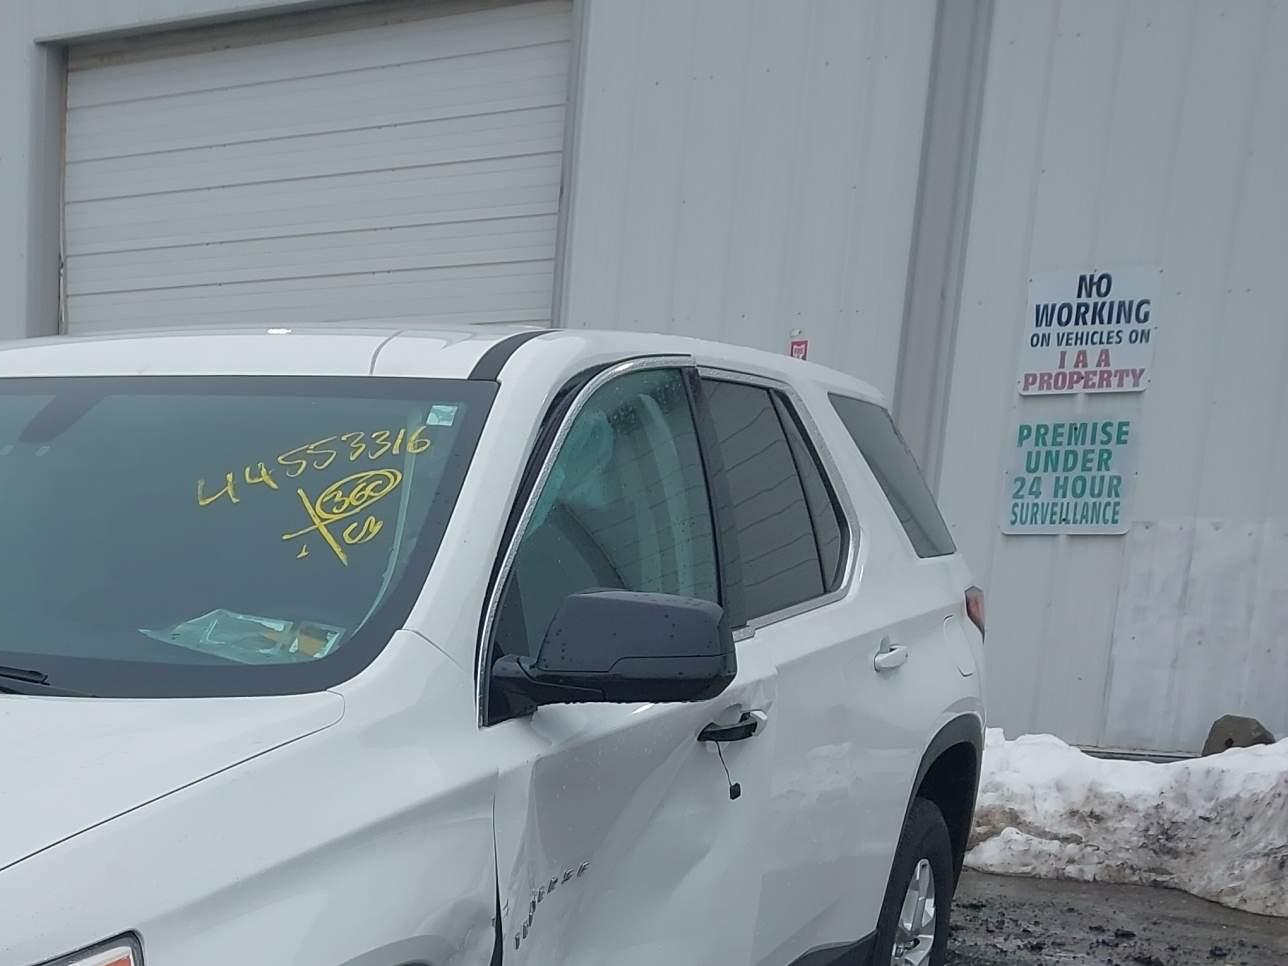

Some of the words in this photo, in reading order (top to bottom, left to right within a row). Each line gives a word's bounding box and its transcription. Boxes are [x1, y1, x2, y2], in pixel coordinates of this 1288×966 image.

[1076, 273, 1112, 299] NO
[1035, 299, 1151, 328] WORKING
[1030, 332, 1050, 348] ON
[1056, 329, 1122, 347] VEHICLES
[1128, 329, 1150, 344] ON
[1023, 368, 1146, 391] PROPERTY
[1017, 421, 1130, 448] PREMISE
[197, 426, 431, 505] 44553316
[1025, 449, 1113, 473] UNDER
[1012, 476, 1042, 500] 24
[1053, 475, 1122, 499] HOUR
[1010, 500, 1120, 525] SURVEILLANCE
